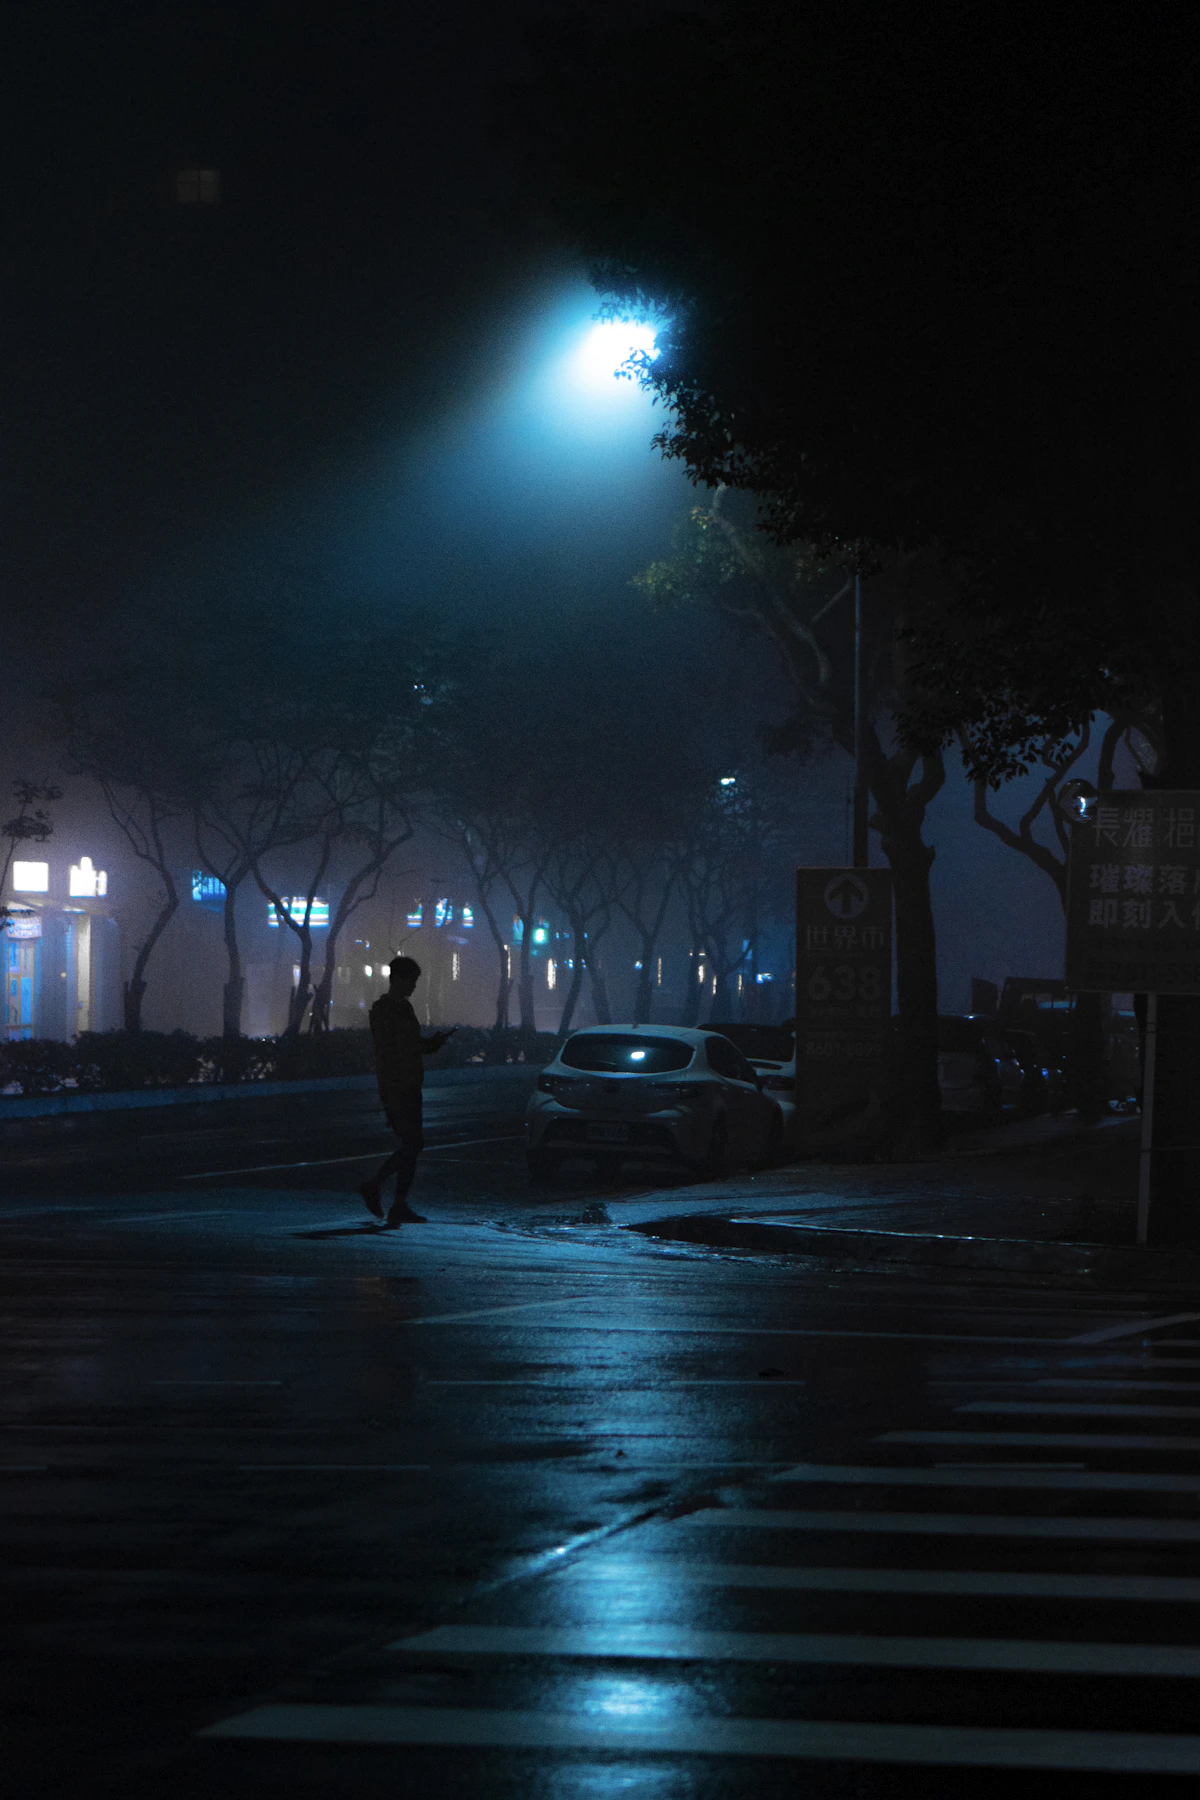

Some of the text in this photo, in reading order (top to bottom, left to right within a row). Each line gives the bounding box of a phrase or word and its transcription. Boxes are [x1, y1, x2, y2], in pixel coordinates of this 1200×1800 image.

[1092, 807, 1200, 848] 長耀挹
[1089, 863, 1200, 895] 璀璨落
[1089, 899, 1200, 930] 即刻入
[806, 925, 884, 950] 世界市
[808, 964, 882, 1001] 638
